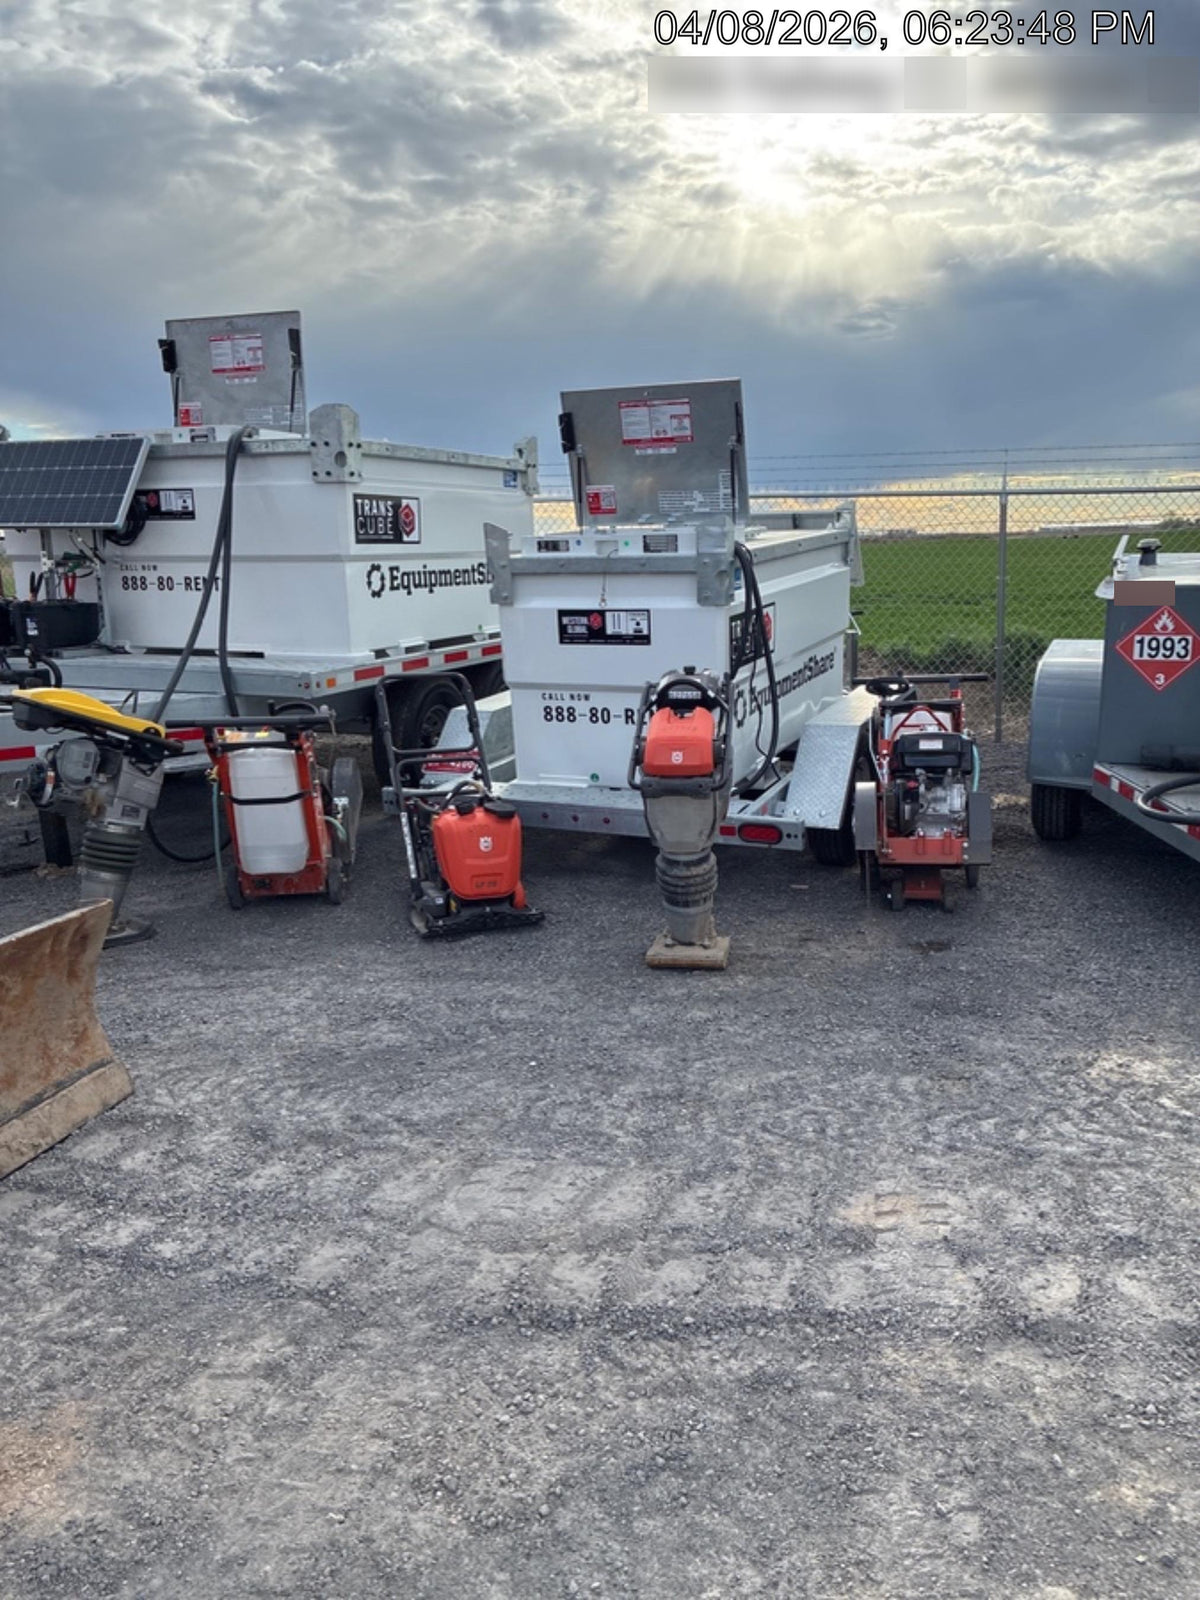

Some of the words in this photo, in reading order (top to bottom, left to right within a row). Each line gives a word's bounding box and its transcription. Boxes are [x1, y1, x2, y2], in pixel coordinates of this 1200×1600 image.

[356, 499, 394, 516] TRANS
[357, 517, 394, 534] CUBE
[1136, 637, 1190, 659] 1993
[1155, 673, 1165, 685] 3
[541, 693, 565, 701] CALL
[569, 693, 591, 701] NOW
